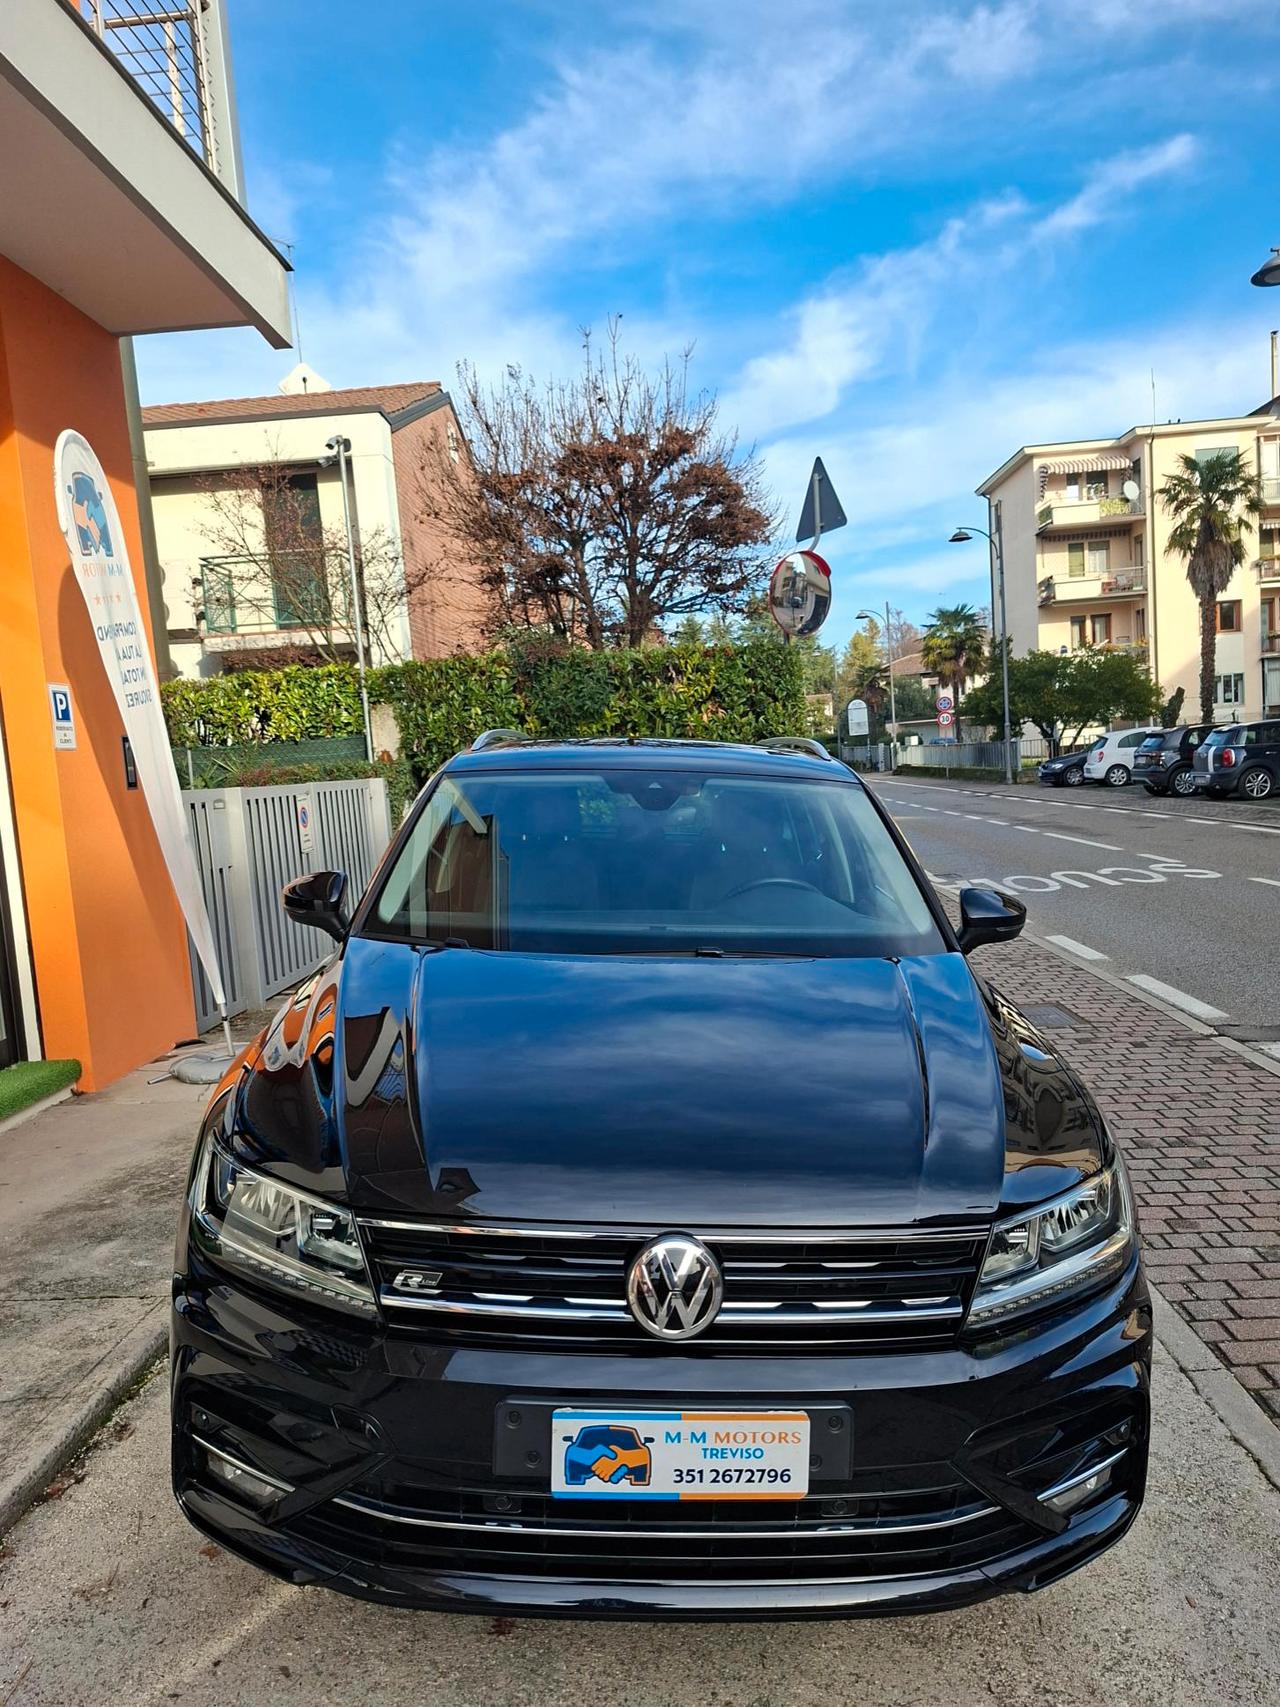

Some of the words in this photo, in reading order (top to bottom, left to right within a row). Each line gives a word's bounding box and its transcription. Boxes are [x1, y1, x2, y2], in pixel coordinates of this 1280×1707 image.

[55, 693, 67, 719] P
[664, 1431, 707, 1444] M-M
[714, 1431, 802, 1445] MOTORS
[702, 1447, 765, 1460] TREVISO
[673, 1469, 704, 1484] 351
[709, 1468, 792, 1484] 2672796
